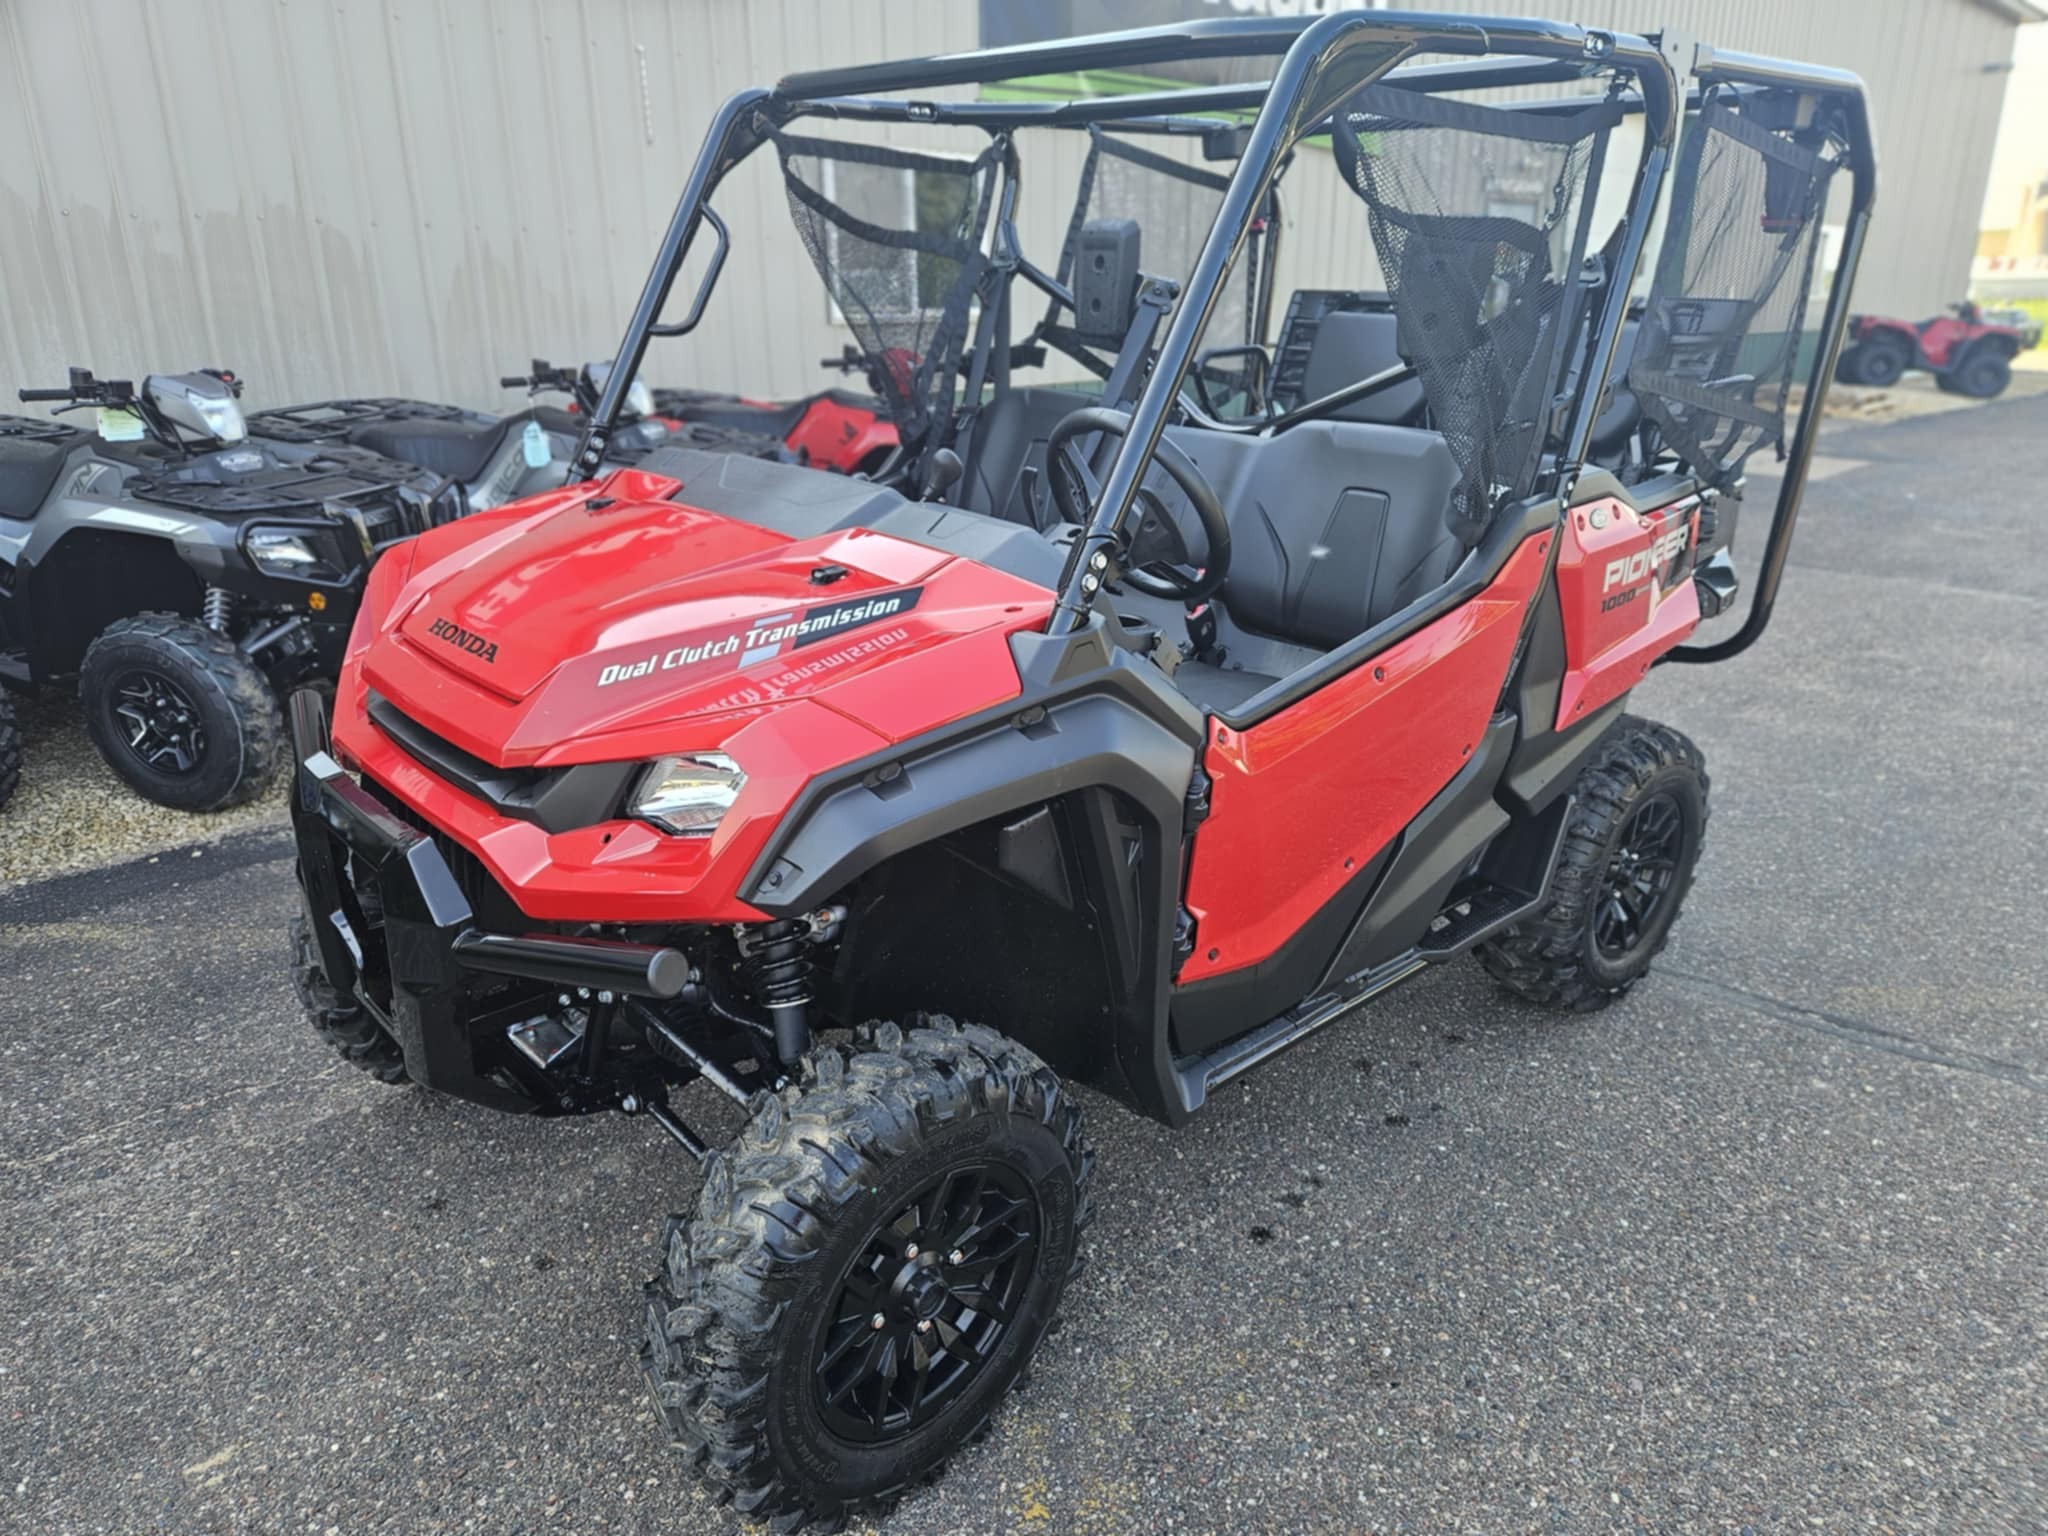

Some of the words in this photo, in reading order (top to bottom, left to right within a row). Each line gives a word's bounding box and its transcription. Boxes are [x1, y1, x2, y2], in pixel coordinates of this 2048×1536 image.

[1601, 588, 1637, 613] 1000
[428, 618, 499, 663] HONDA
[597, 655, 659, 687] Dual
[661, 634, 740, 670] Clutch
[746, 598, 901, 648] Transmission
